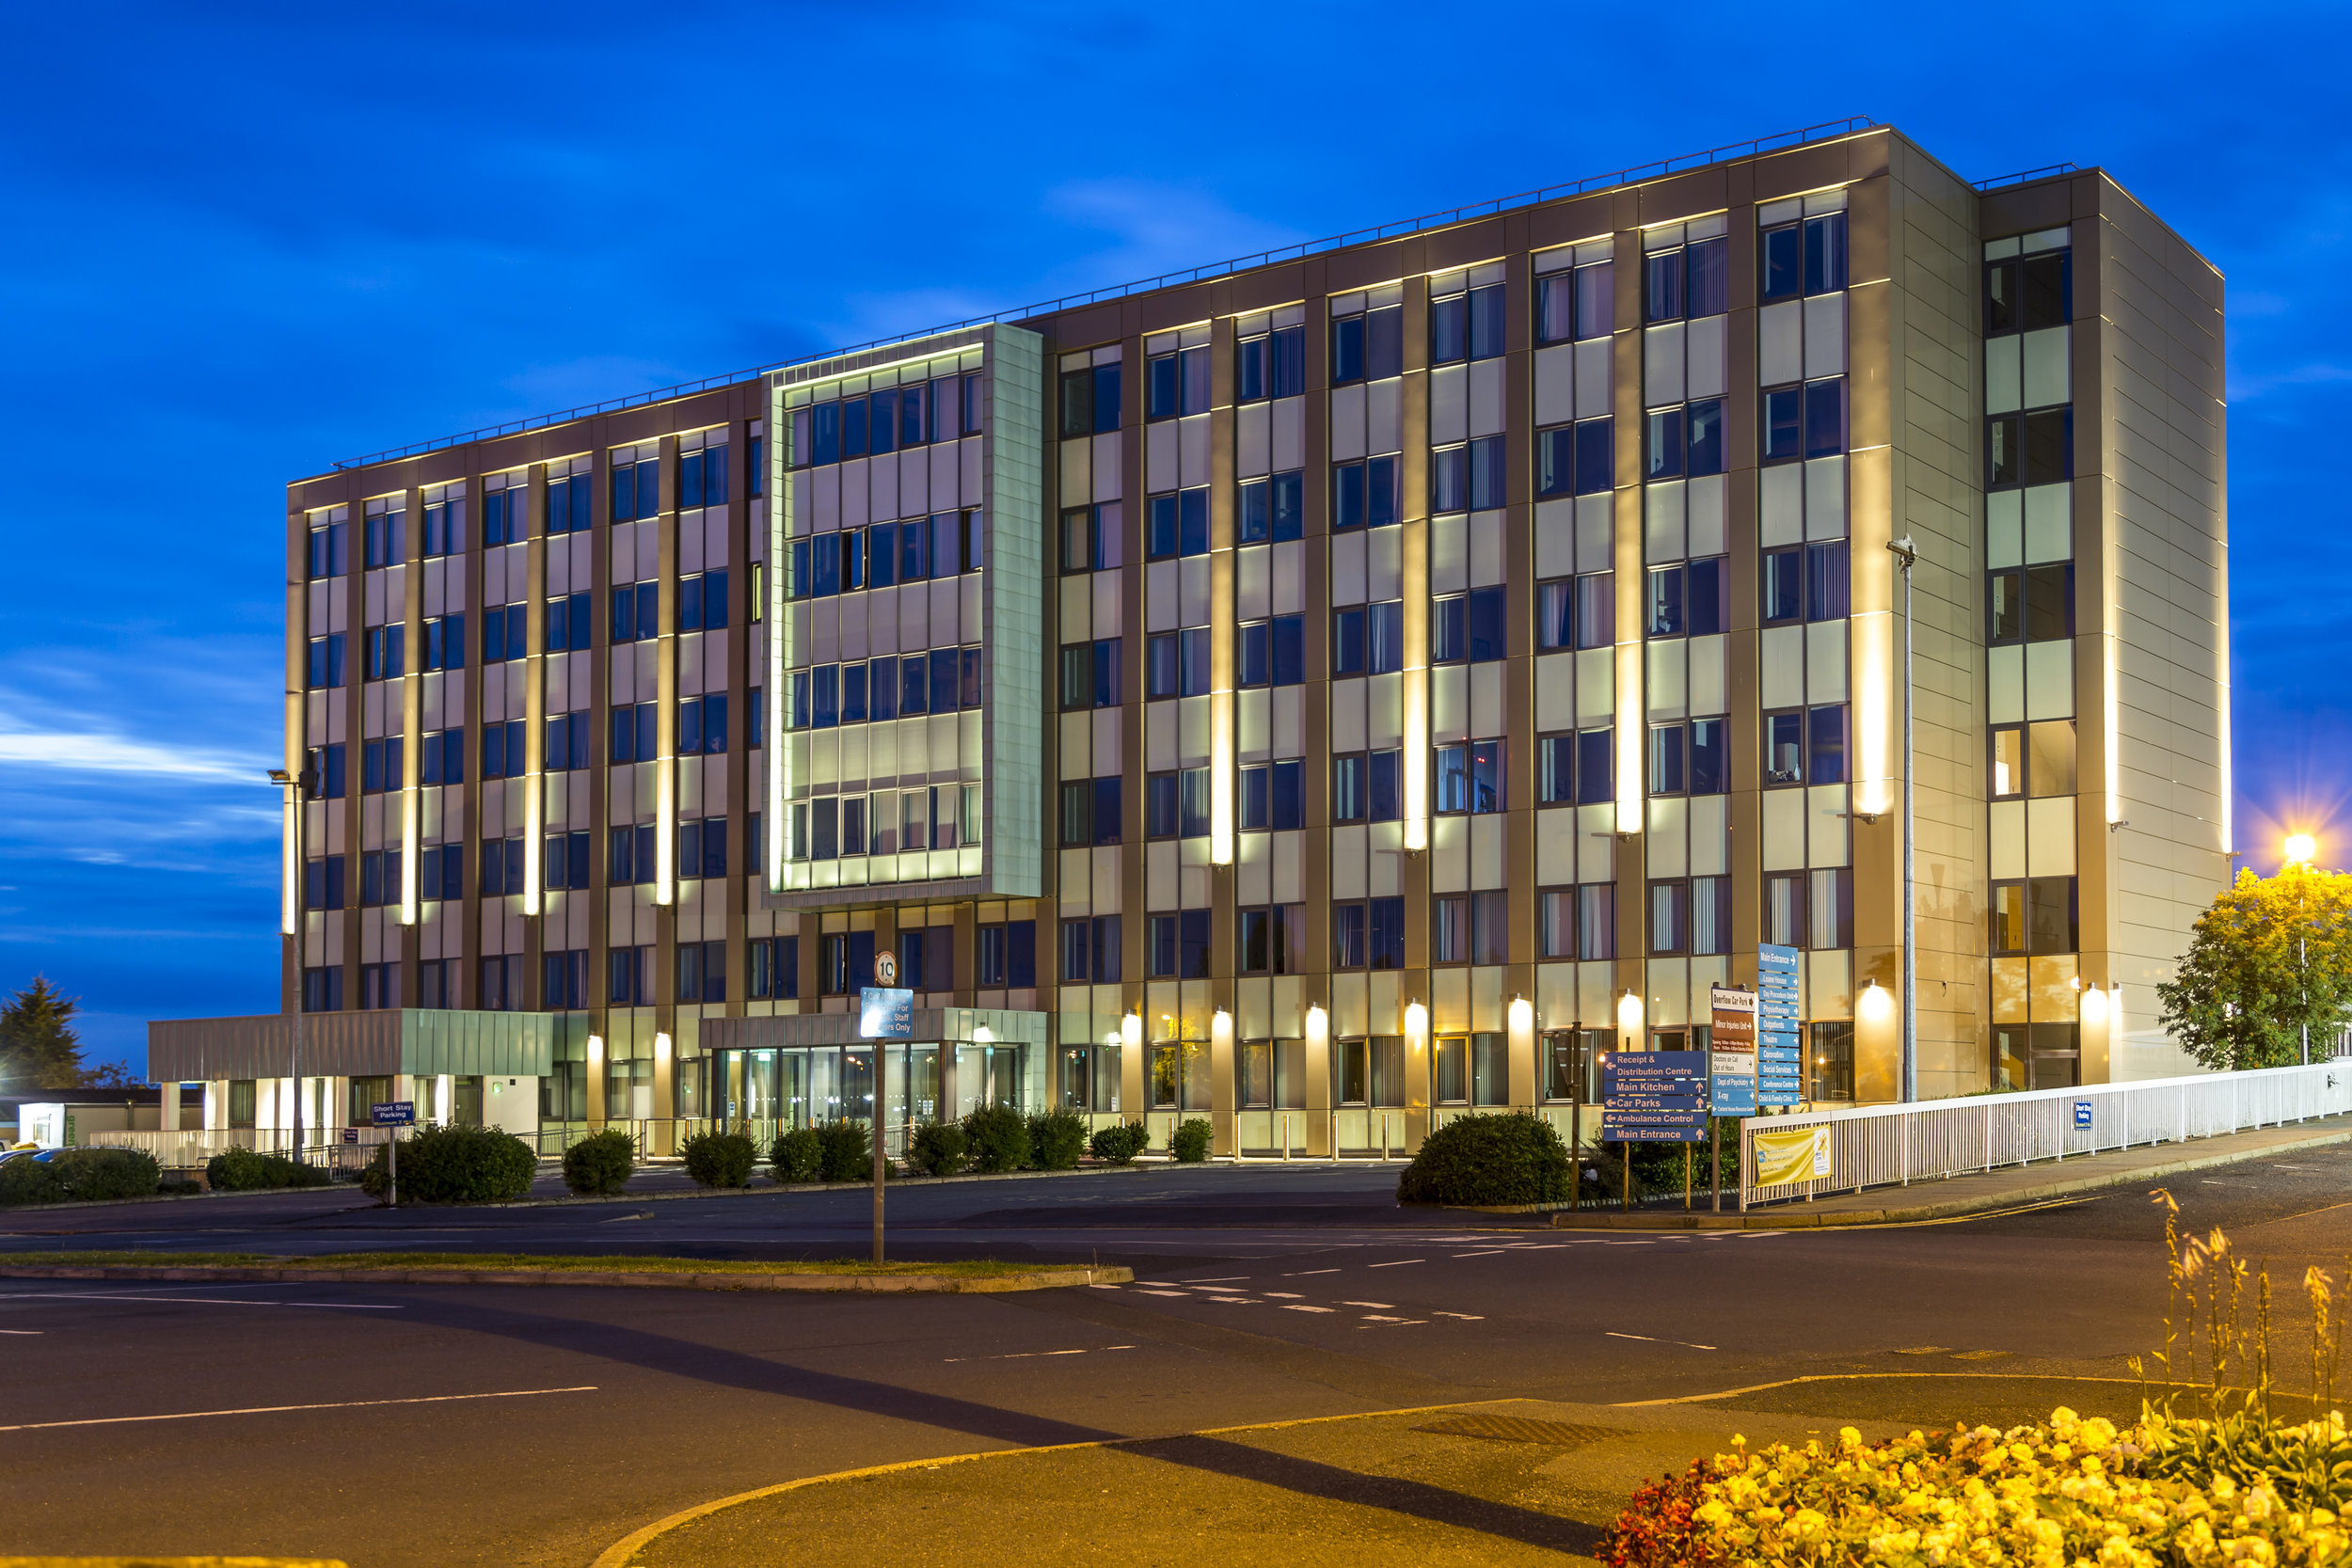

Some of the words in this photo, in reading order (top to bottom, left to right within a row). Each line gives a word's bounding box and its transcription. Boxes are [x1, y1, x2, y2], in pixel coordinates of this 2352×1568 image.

[1760, 952, 1771, 961] Main
[1771, 953, 1789, 964] Entrance
[880, 961, 894, 976] 10
[1713, 993, 1731, 1004] Overflow
[1739, 996, 1748, 1006] Park
[1762, 1005, 1789, 1017] Physiotherapy
[894, 1013, 910, 1022] Staff
[895, 1023, 911, 1033] Only
[1715, 1020, 1726, 1029] Minor
[1726, 1021, 1740, 1031] Injuries
[1762, 1020, 1785, 1030] Outpatients
[1762, 1035, 1778, 1044] Theatre
[1762, 1050, 1785, 1059] Coronation
[1617, 1055, 1647, 1064] Receipt
[1648, 1055, 1655, 1064] &
[1762, 1064, 1775, 1074] Social
[1775, 1065, 1792, 1075] Services
[1616, 1083, 1637, 1091] Main
[1640, 1083, 1676, 1091] Kitchen
[1731, 1078, 1748, 1087] Psychiatry
[1762, 1080, 1783, 1089] Conference
[1782, 1081, 1794, 1089] Centre
[1717, 1091, 1729, 1101] X-ray
[1758, 1094, 1768, 1102] Child
[1772, 1094, 1783, 1103] Family
[1616, 1099, 1633, 1108] Car
[1635, 1099, 1661, 1108] Parks
[1617, 1115, 1662, 1123] Ambulance
[1663, 1115, 1693, 1123] Control
[2078, 1112, 2090, 1120] Parking
[1616, 1130, 1638, 1138] Main
[1640, 1130, 1681, 1138] Entrance
